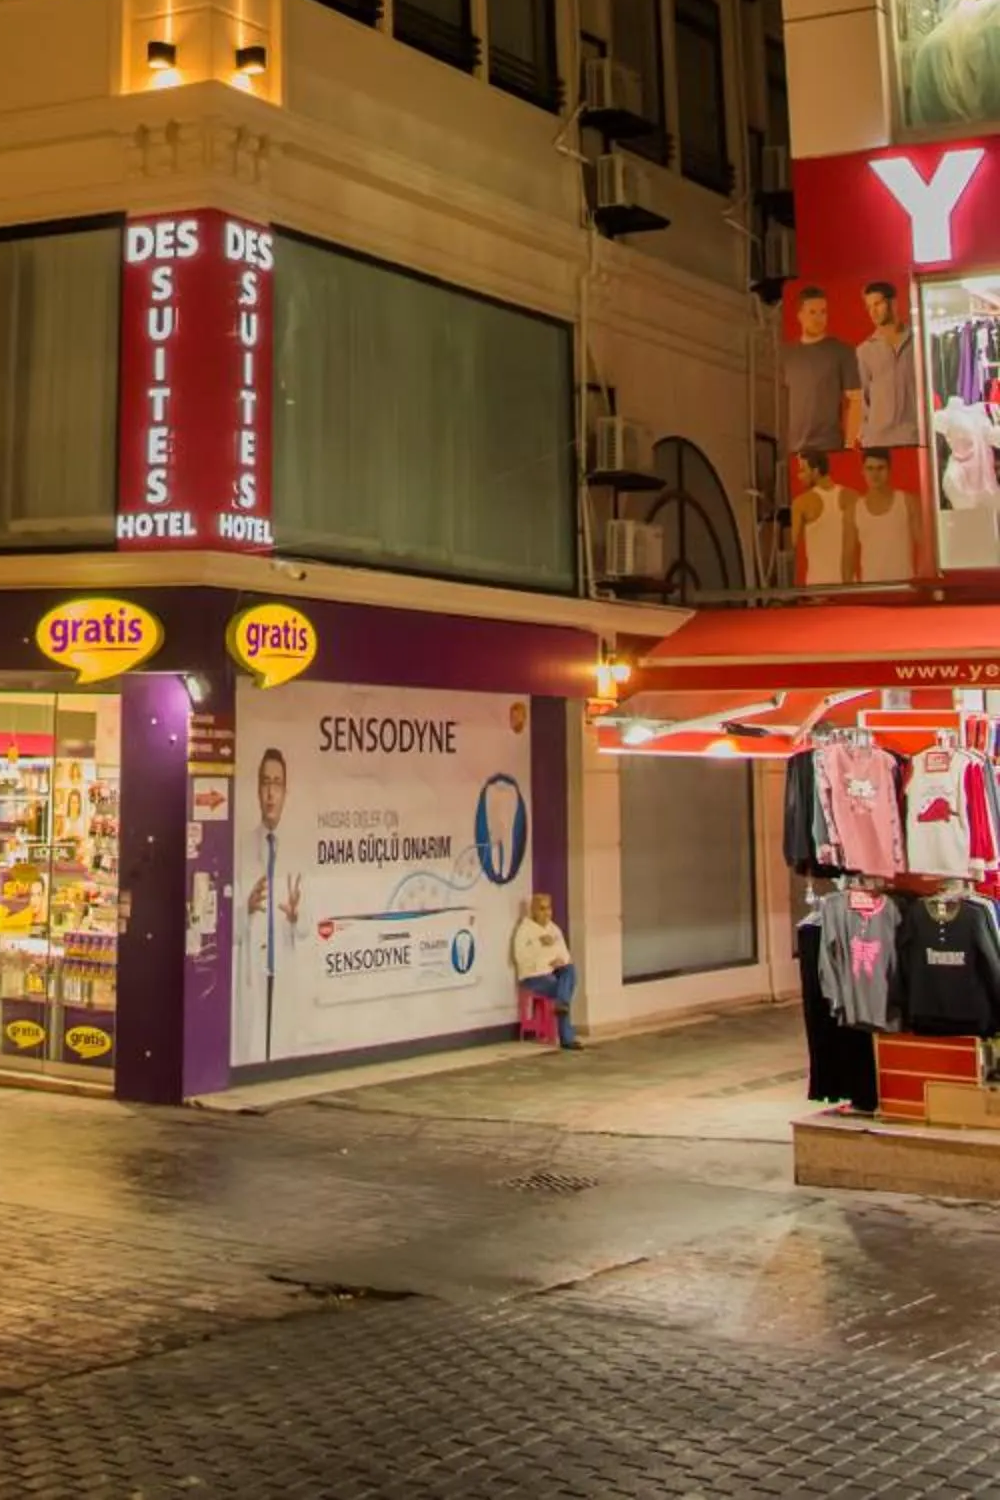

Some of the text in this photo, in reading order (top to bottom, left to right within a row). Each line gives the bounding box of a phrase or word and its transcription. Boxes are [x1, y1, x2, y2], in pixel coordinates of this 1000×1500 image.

[868, 147, 985, 264] Y
[126, 220, 199, 263] DES
[224, 221, 274, 271] DES
[116, 512, 197, 538] HOTEL
[218, 513, 273, 544] HOTEL
[50, 608, 143, 653] gratis
[246, 617, 308, 657] gratis
[319, 716, 458, 754] SENSODYNE
[317, 833, 452, 869] DAHA GÜÇLÜ ONARIM
[326, 945, 412, 974] SENSODYNE
[70, 1032, 105, 1046] gratis
